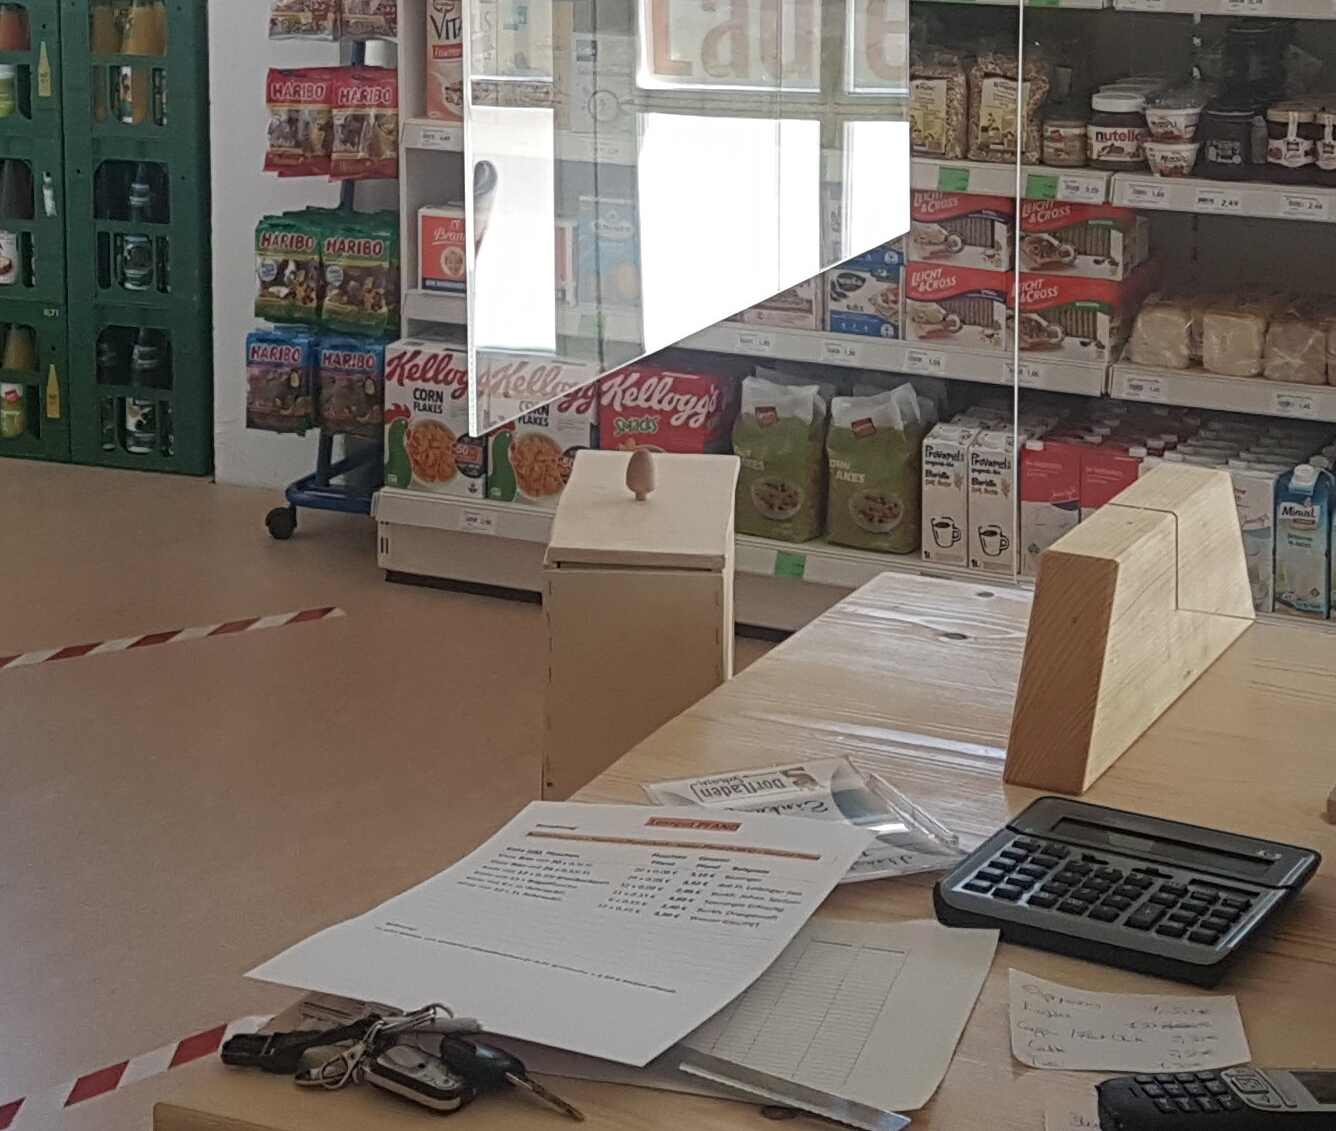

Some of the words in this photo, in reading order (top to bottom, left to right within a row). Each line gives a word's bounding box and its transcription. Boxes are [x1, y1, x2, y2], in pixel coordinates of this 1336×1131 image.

[270, 83, 324, 101] HARIBO
[339, 87, 391, 105] HARIBO
[260, 232, 314, 251] HARIBO
[325, 238, 383, 257] HARIBO
[911, 269, 943, 286] LEICHT
[918, 276, 957, 292] &CROSS
[250, 344, 301, 363] HARIBO
[322, 350, 375, 369] HARIBO
[413, 388, 443, 403] CORN
[601, 372, 719, 428] Kellogg's
[413, 403, 443, 414] FLAKES
[700, 776, 787, 801] Dorfladen
